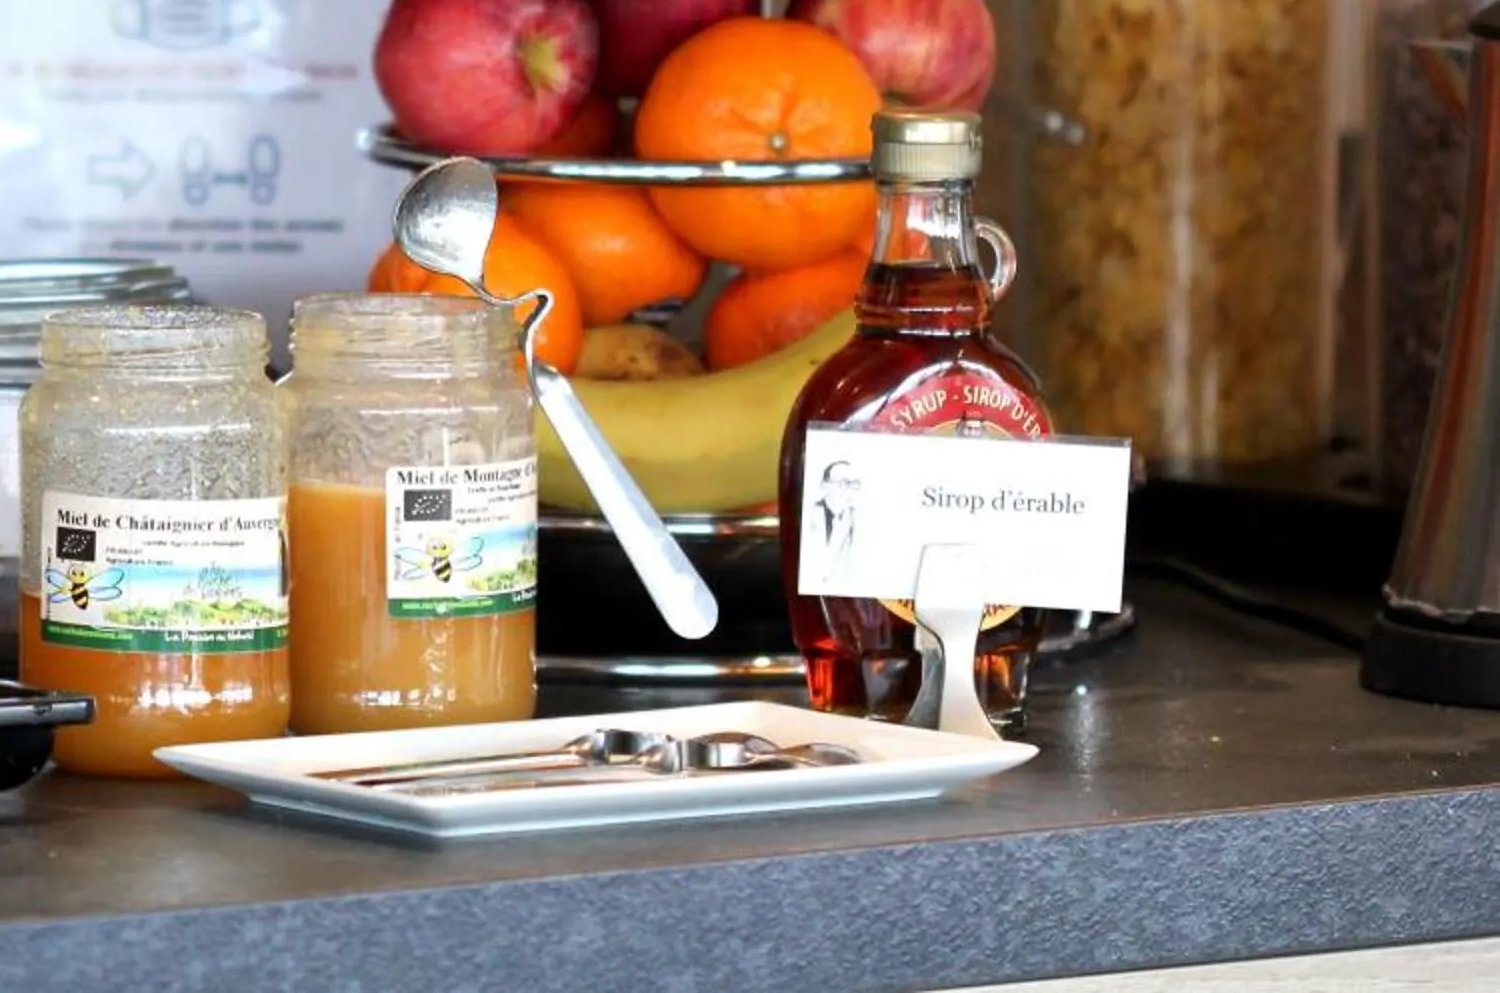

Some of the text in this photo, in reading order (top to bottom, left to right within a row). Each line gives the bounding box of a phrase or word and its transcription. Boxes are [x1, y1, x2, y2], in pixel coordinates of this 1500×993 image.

[891, 390, 947, 432] SYRUP
[963, 385, 1011, 411] SIROP
[396, 469, 435, 486] Miel
[439, 470, 460, 485] de
[921, 485, 1086, 515] Sirop d'érable
[56, 508, 281, 534] Miel de Châtaignier d'Auverg
